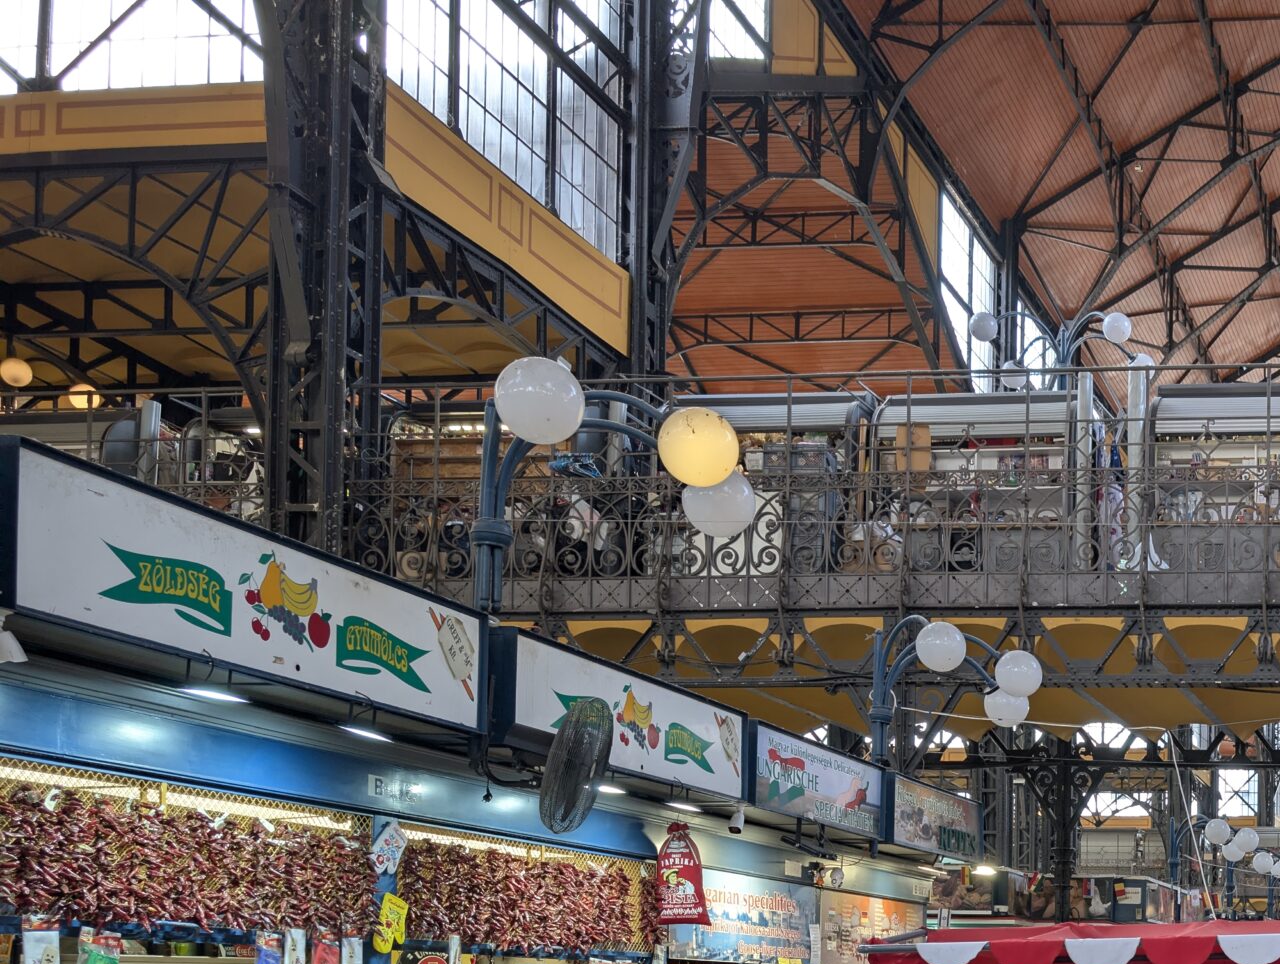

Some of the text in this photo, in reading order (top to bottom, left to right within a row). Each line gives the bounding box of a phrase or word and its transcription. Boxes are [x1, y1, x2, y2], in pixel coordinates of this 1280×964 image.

[138, 559, 221, 613] ZÖLDSÉG
[346, 620, 408, 673] GYÜMÖLCS
[743, 890, 798, 914] specialities
